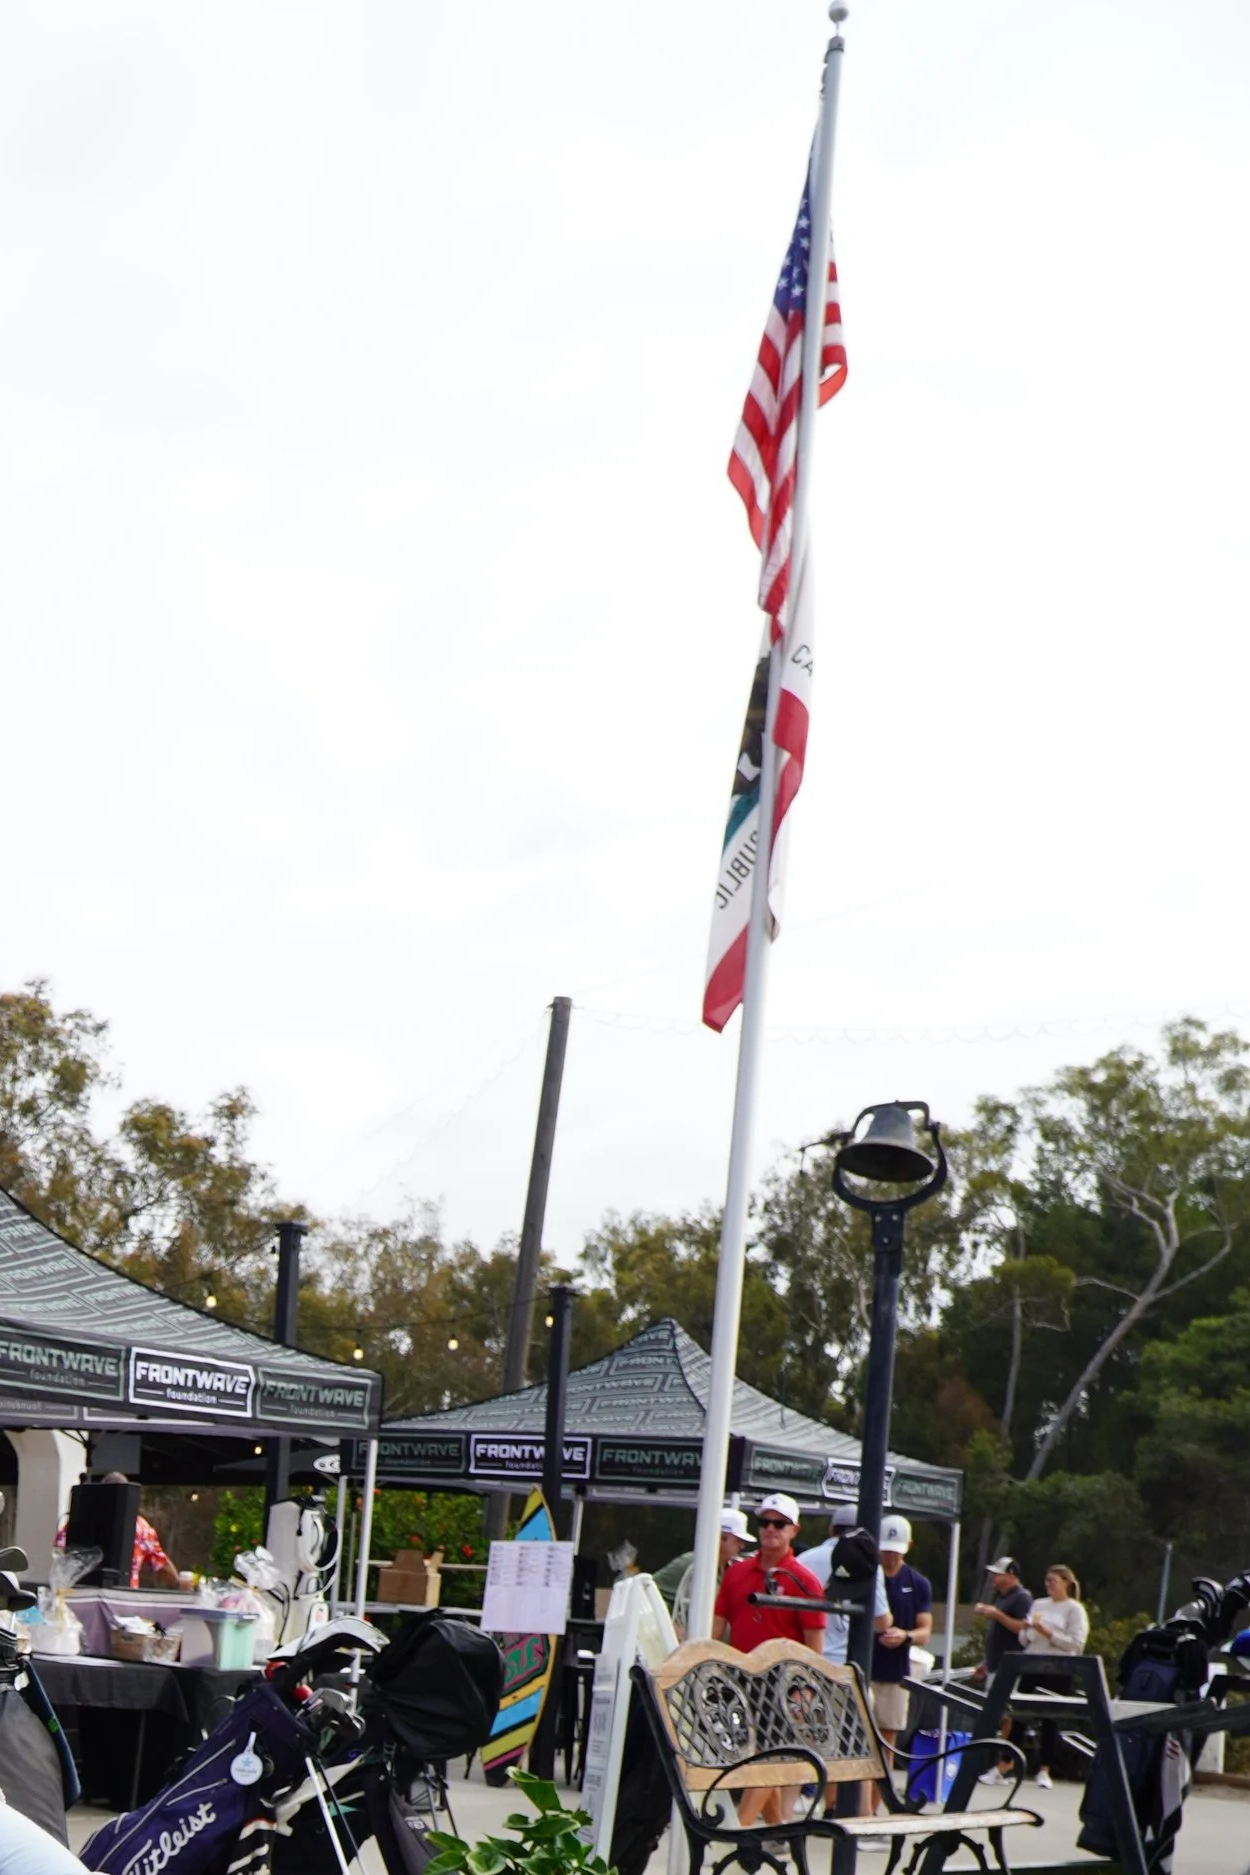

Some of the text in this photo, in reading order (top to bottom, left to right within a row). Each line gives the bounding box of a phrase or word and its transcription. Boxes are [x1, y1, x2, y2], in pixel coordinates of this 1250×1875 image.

[30, 1368, 87, 1387] foundation
[135, 1360, 250, 1395] FRONTWAVE
[166, 1387, 218, 1404] foundation
[262, 1380, 365, 1407] FRONTWAVE
[358, 1441, 460, 1457] FONTWAVE
[475, 1443, 586, 1461] FRONTWVE
[602, 1448, 702, 1467] FRONTWA
